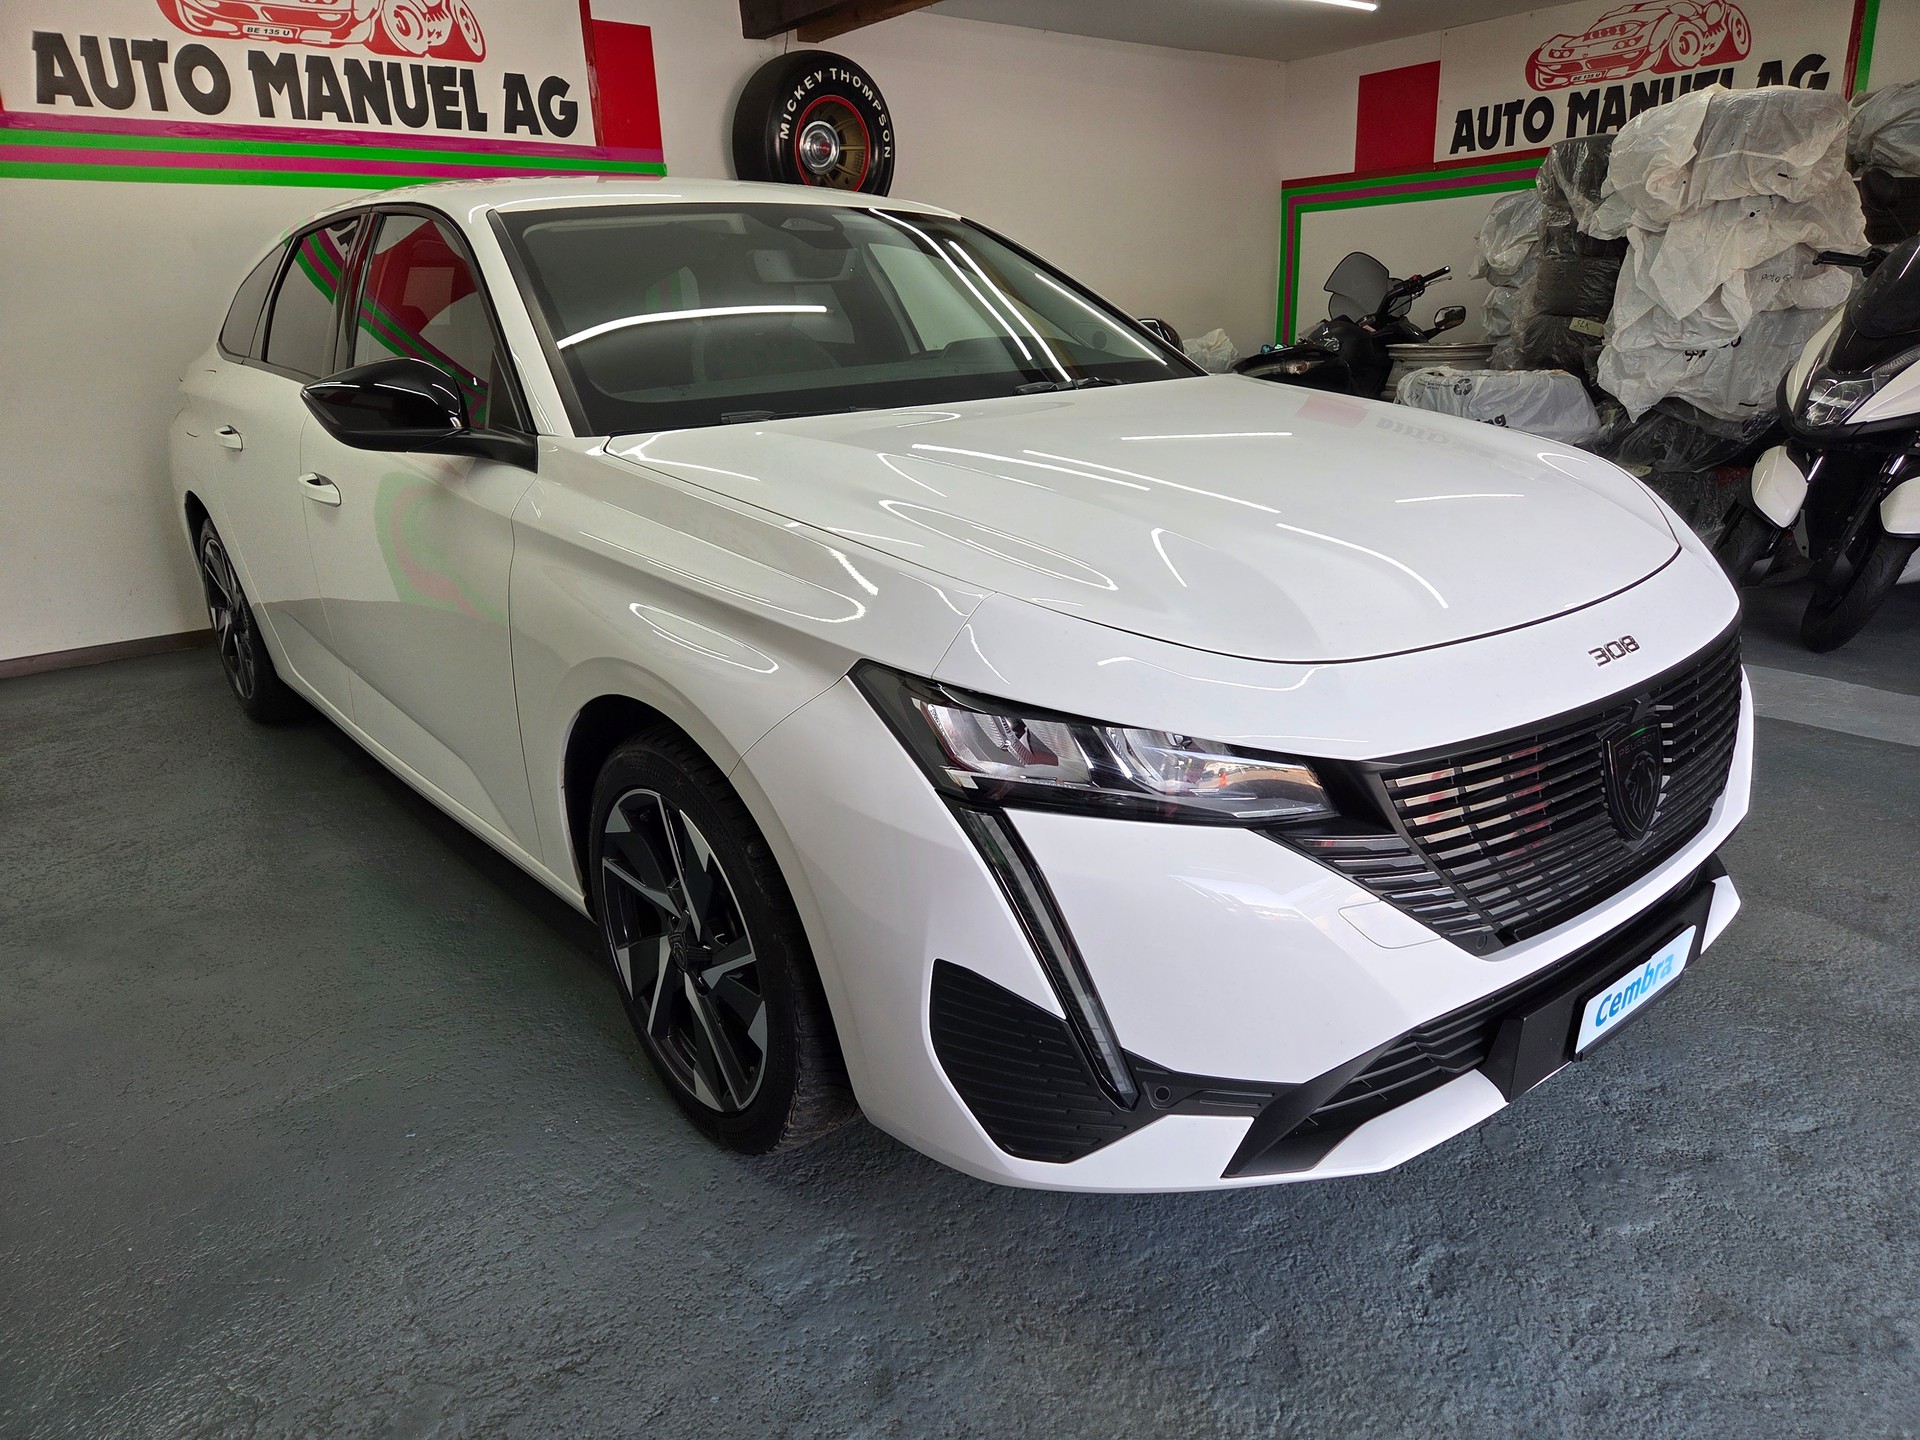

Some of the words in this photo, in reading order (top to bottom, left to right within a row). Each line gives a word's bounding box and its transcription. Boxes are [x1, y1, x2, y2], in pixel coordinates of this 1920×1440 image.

[246, 26, 260, 34] BE
[263, 28, 280, 36] 135
[32, 30, 231, 116] AUTO
[247, 49, 488, 132] MANUEL
[503, 72, 579, 139] AG
[779, 70, 822, 140] MICKEY
[828, 67, 891, 158] THOMPSON
[1449, 96, 1555, 155] AUTO
[1587, 634, 1641, 668] 308
[1618, 731, 1657, 757] PEUGEOT
[1595, 953, 1675, 1028] Cembra
